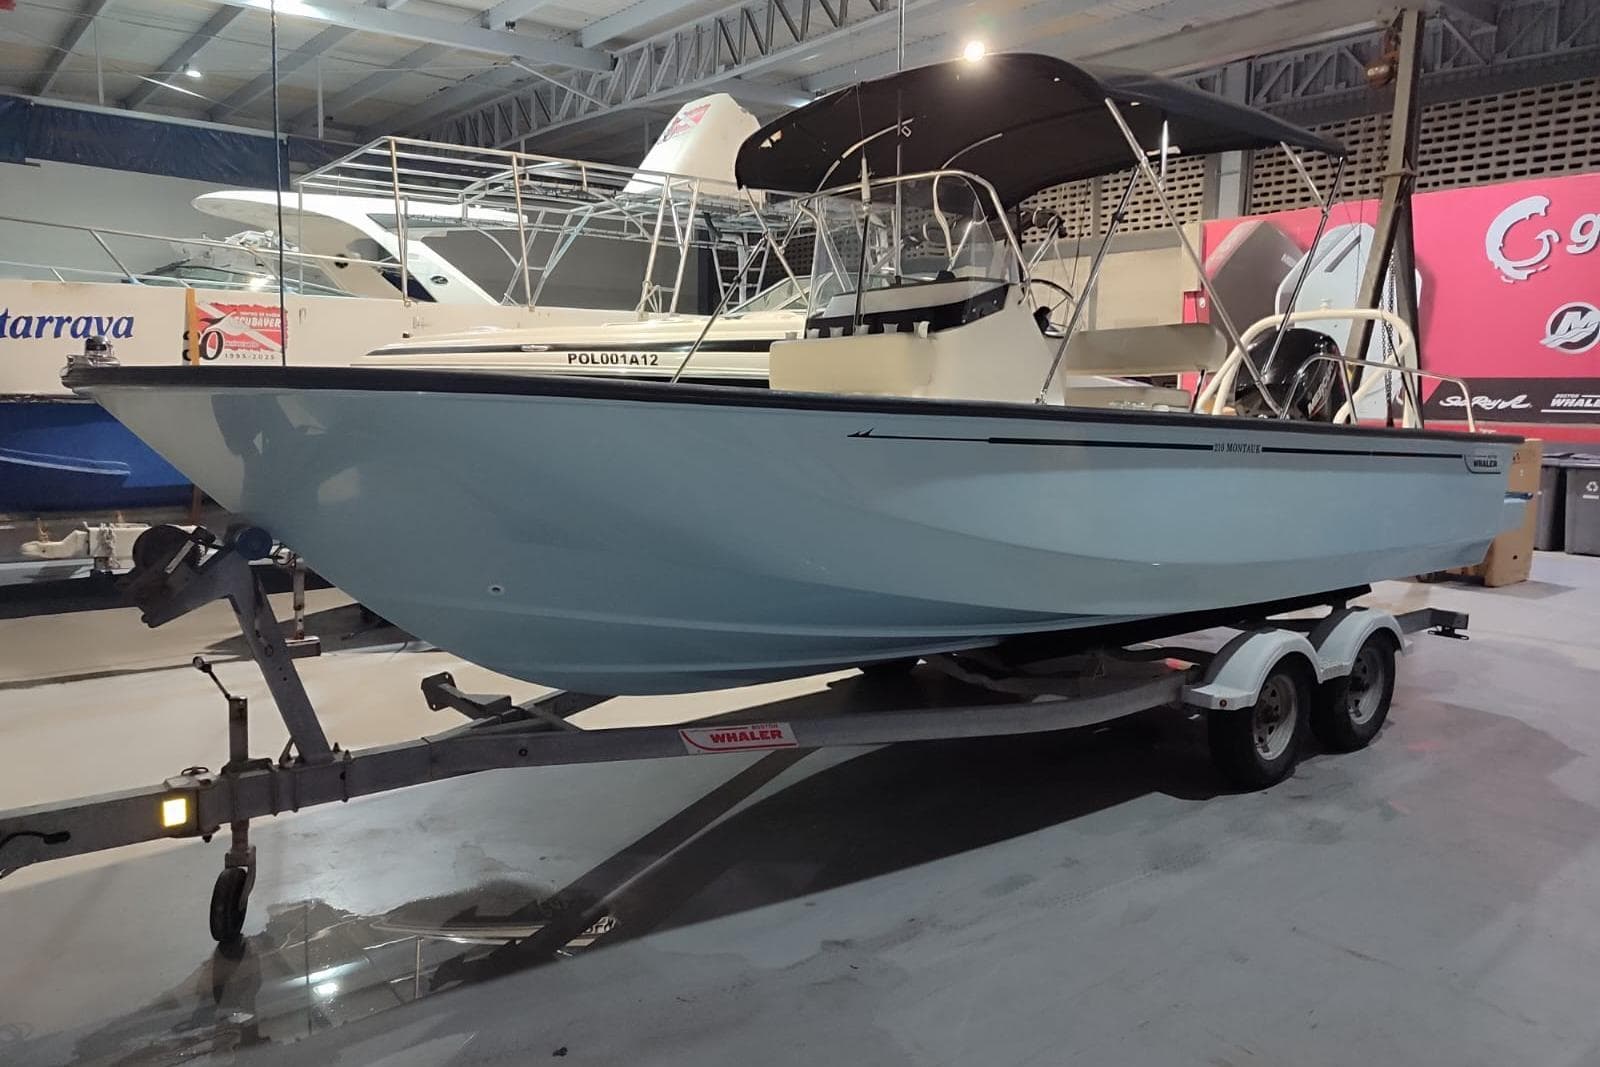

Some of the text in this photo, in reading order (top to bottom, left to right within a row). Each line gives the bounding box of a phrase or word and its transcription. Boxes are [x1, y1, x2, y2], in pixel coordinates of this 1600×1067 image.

[567, 352, 659, 367] POL001A12
[1226, 443, 1261, 454] MONTAUK
[709, 729, 784, 744] WHALER
